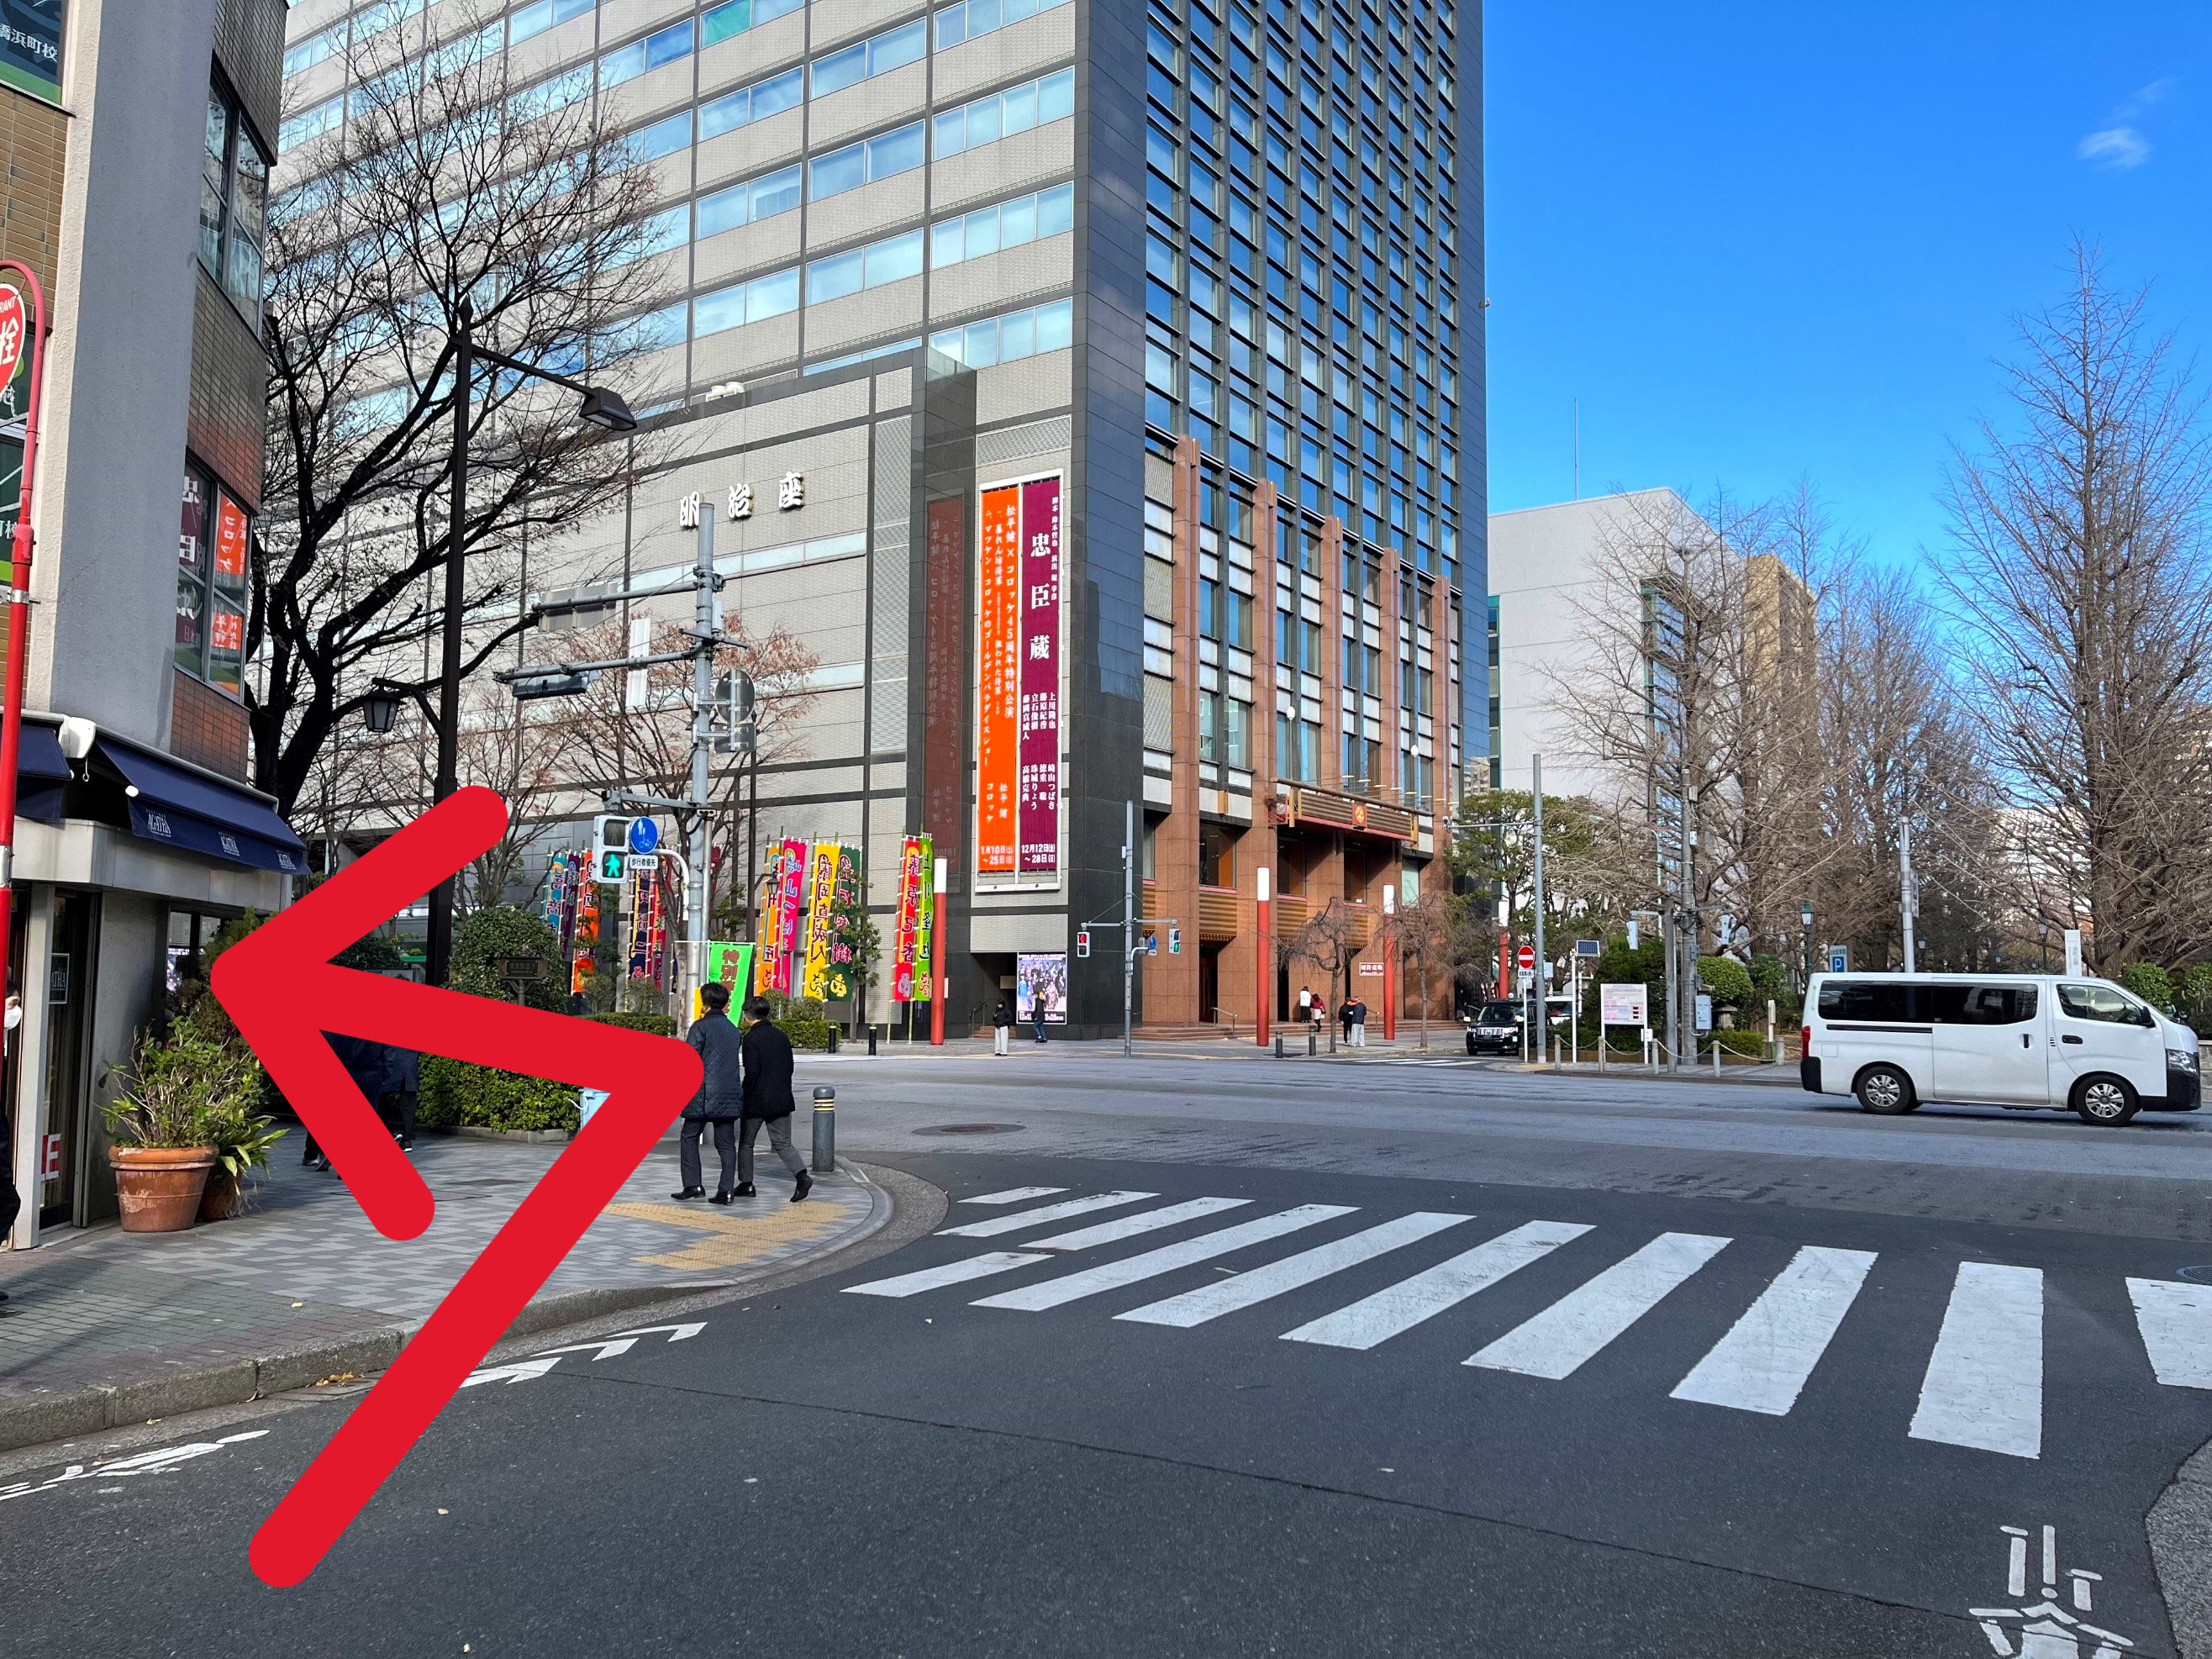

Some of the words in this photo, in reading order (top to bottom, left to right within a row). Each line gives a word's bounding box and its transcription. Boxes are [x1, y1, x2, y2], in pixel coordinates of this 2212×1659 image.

[679, 471, 803, 527] 明治座
[1030, 532, 1051, 661] 忠臣蔵
